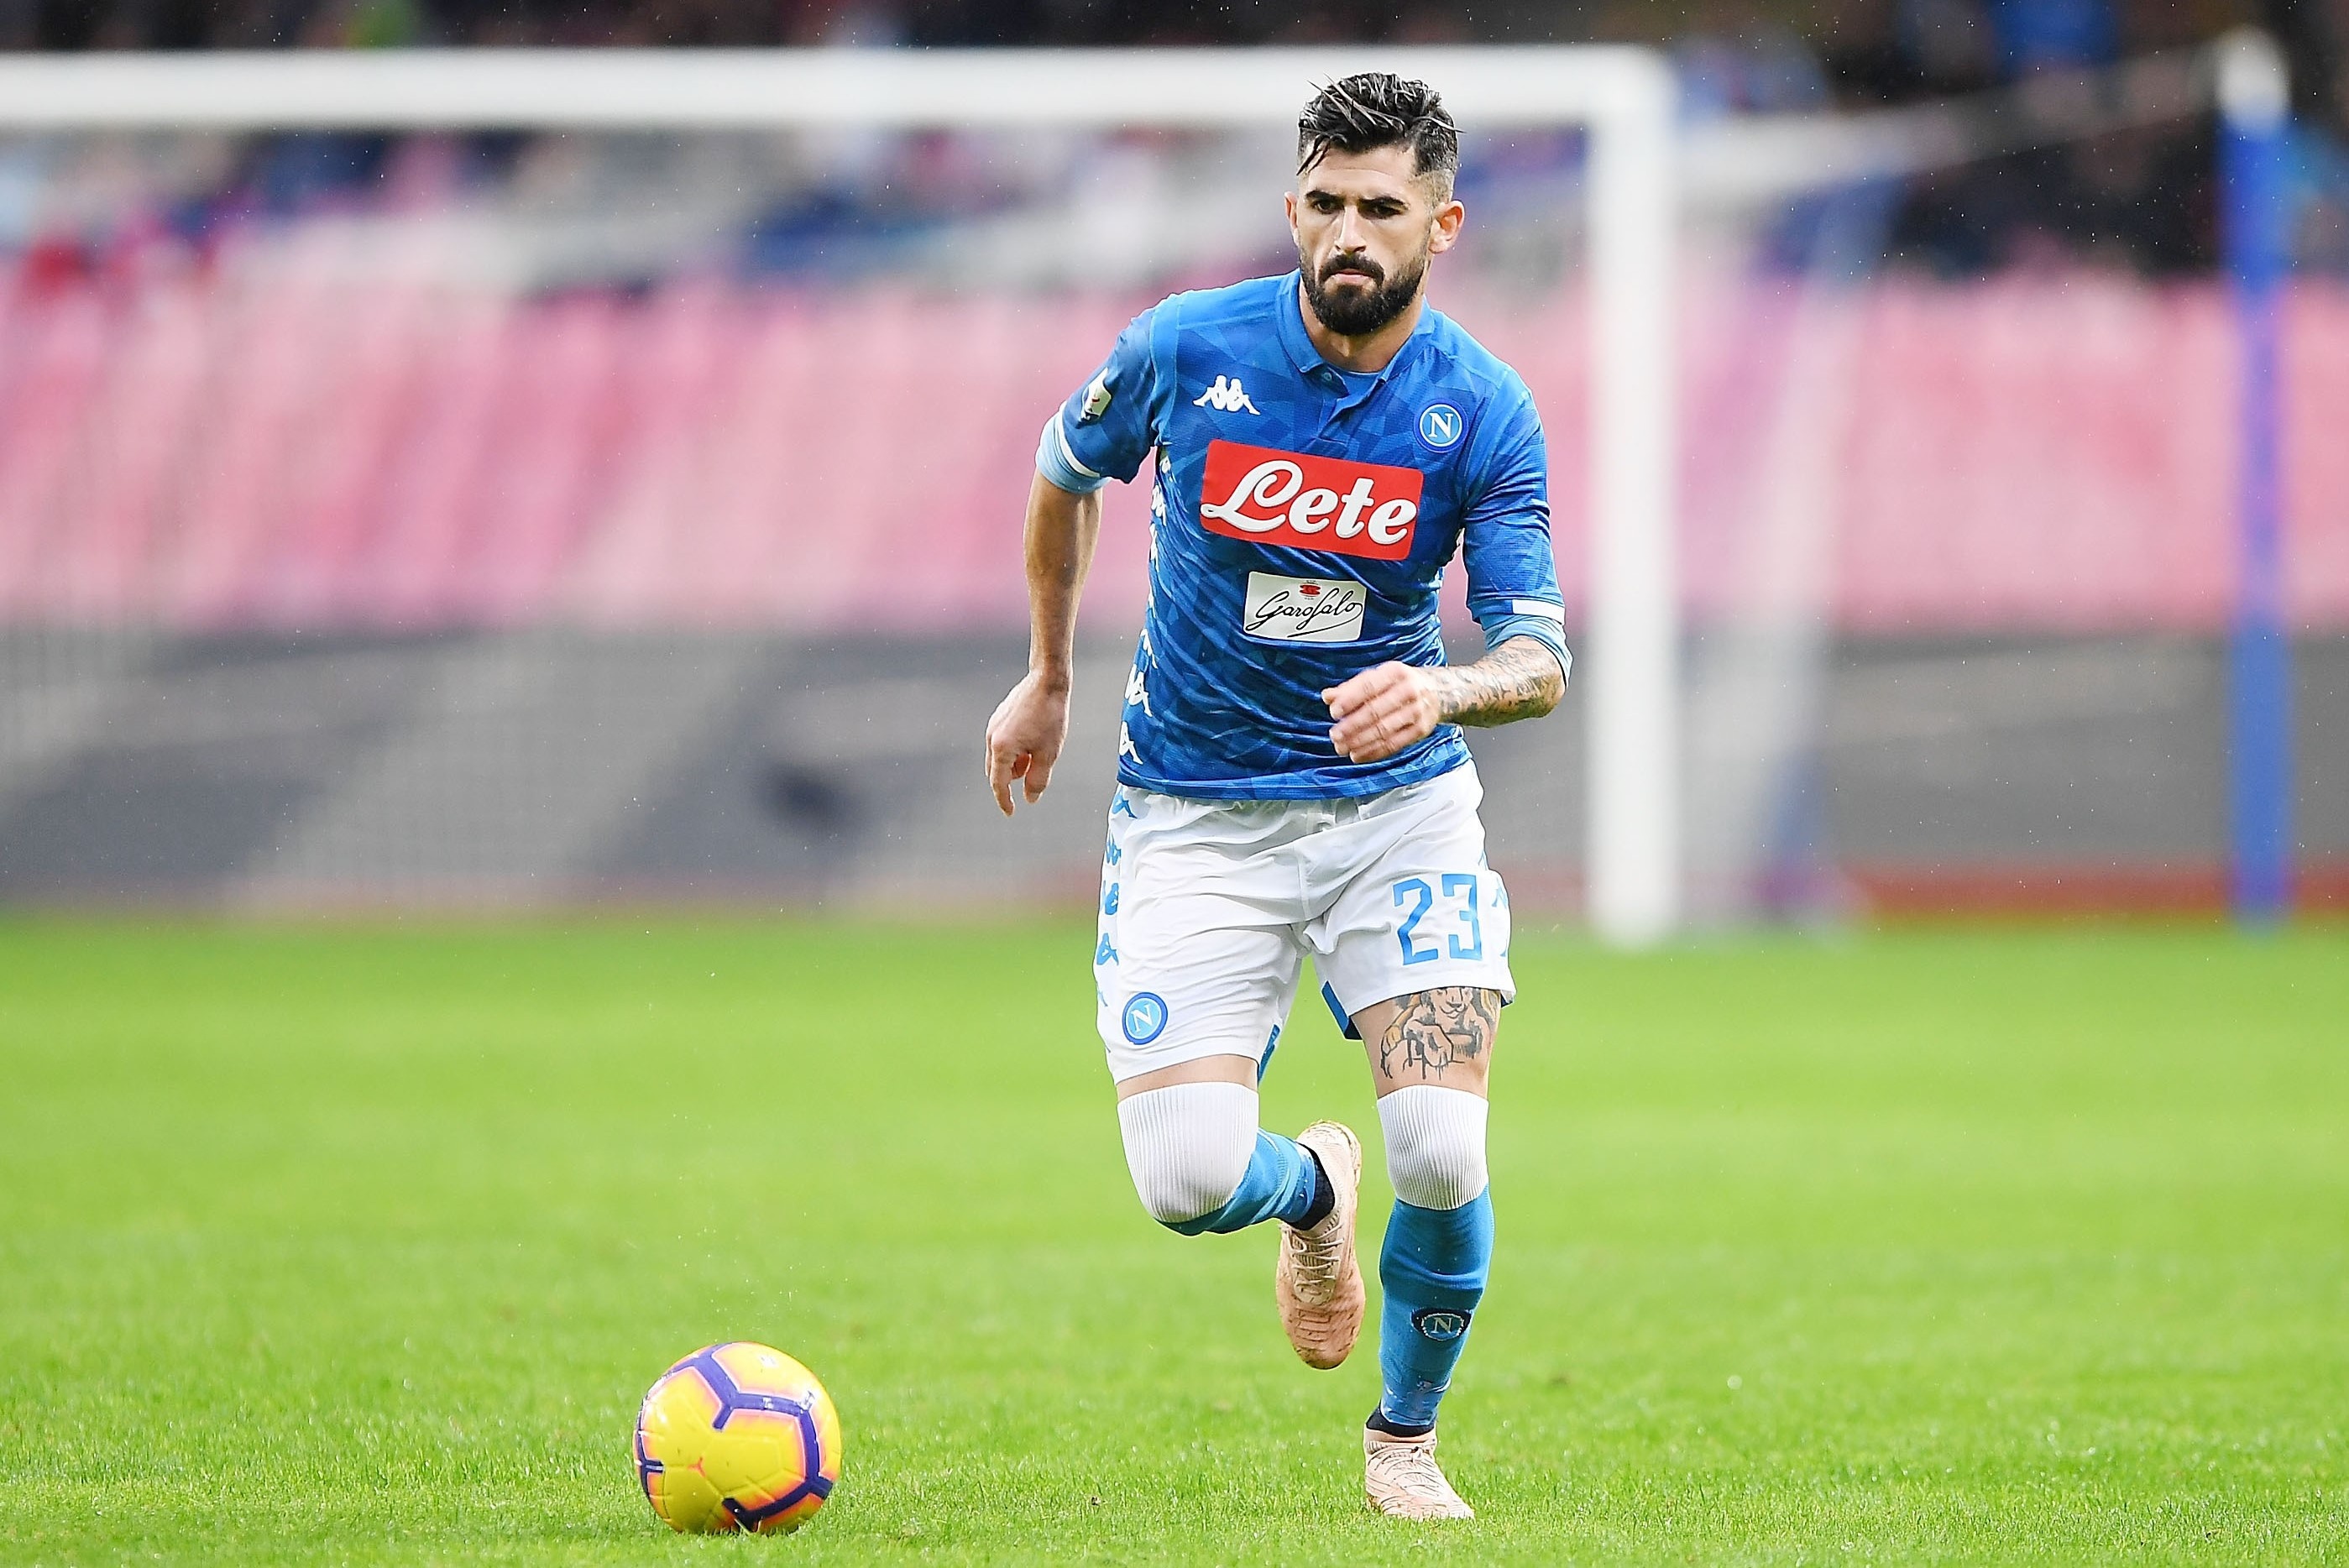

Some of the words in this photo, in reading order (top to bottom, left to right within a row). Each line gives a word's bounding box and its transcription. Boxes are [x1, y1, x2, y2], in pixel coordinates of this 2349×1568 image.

[1428, 412, 1454, 439] N
[1200, 459, 1418, 545] Lete
[1245, 587, 1363, 637] Garofalo
[1393, 873, 1483, 965] 23
[1130, 1004, 1154, 1032] N
[1431, 1317, 1452, 1333] N
